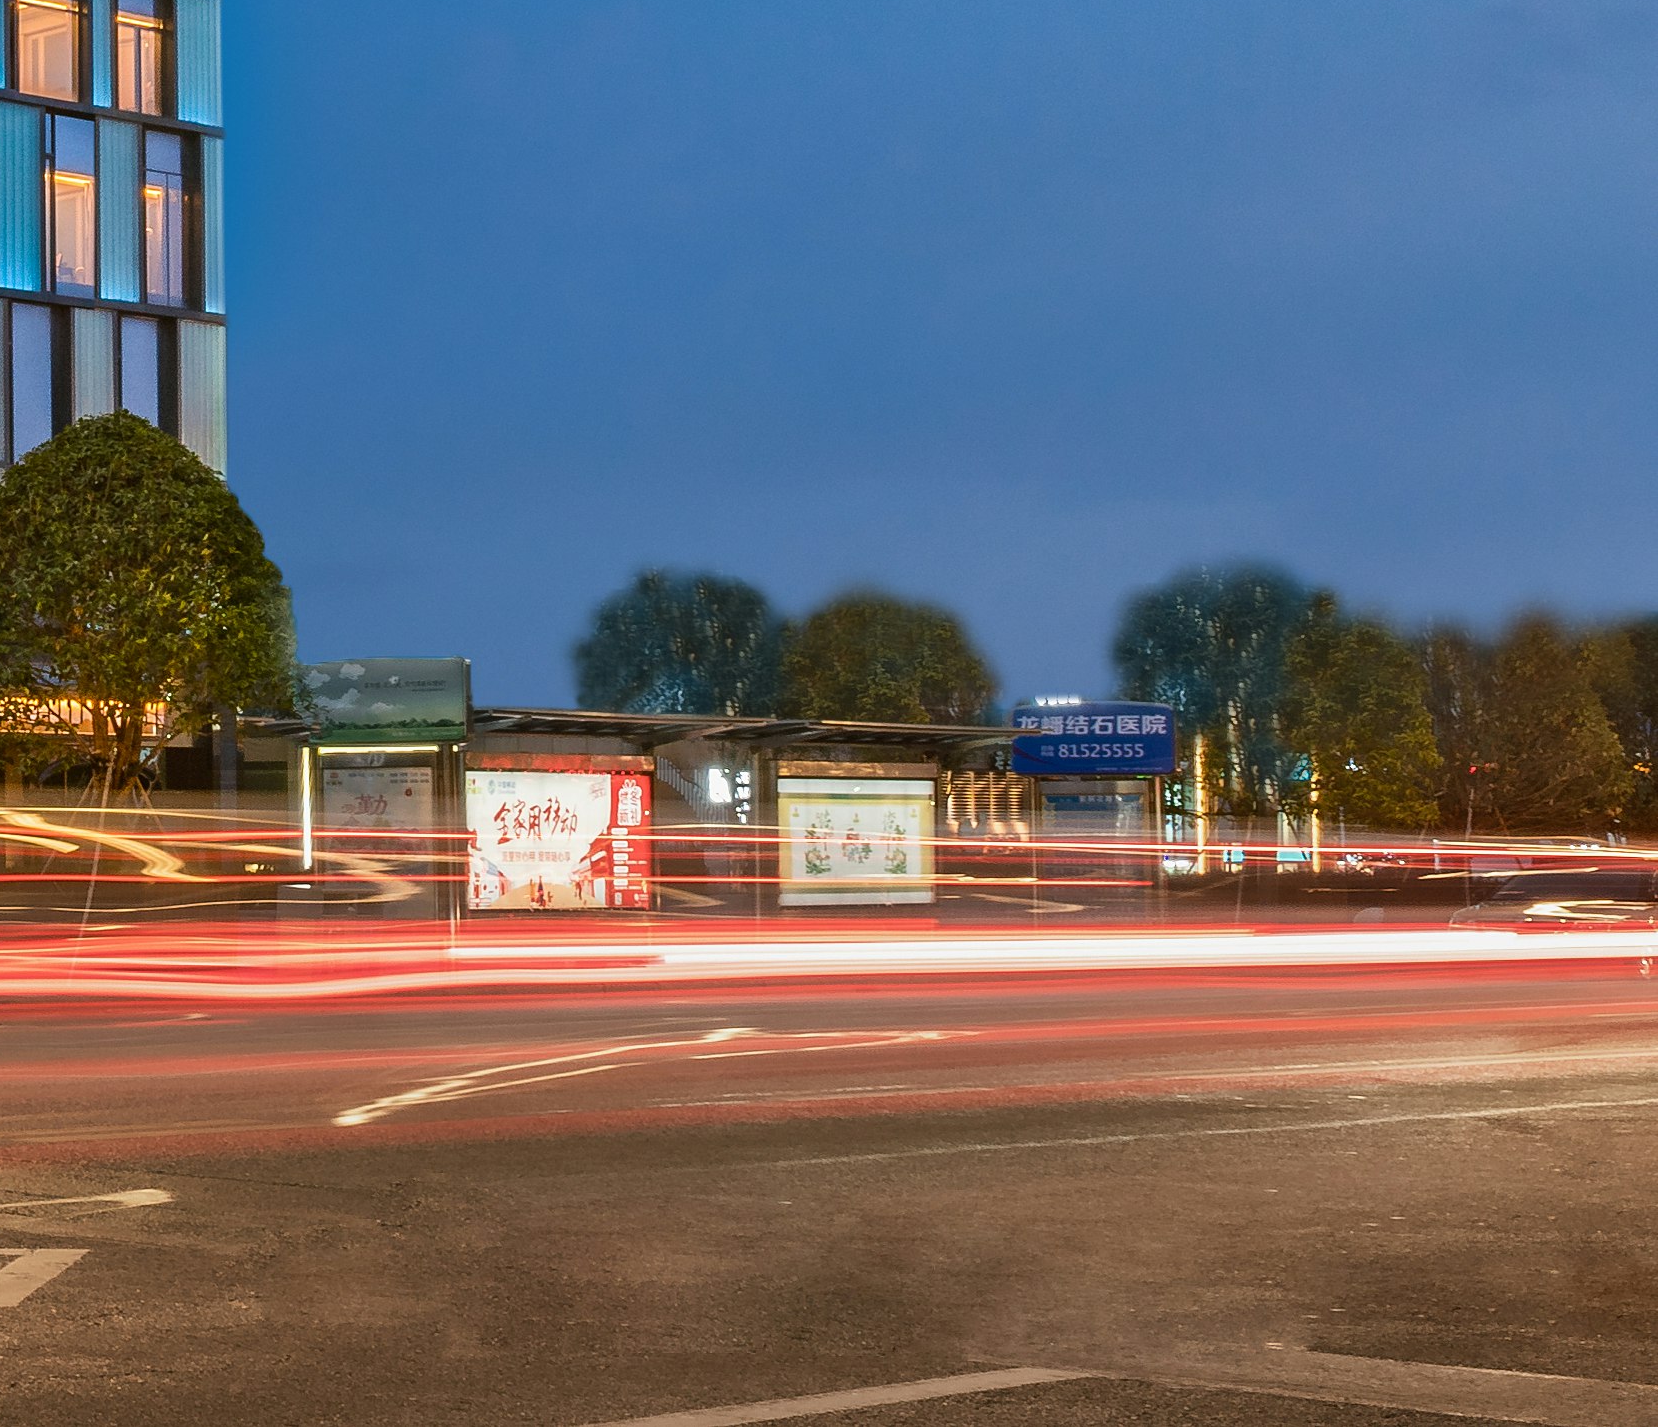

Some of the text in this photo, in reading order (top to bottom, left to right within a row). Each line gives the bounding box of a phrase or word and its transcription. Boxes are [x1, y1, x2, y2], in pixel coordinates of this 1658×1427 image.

[1058, 743, 1144, 758] 81525555
[494, 796, 577, 844] 全家用移动
